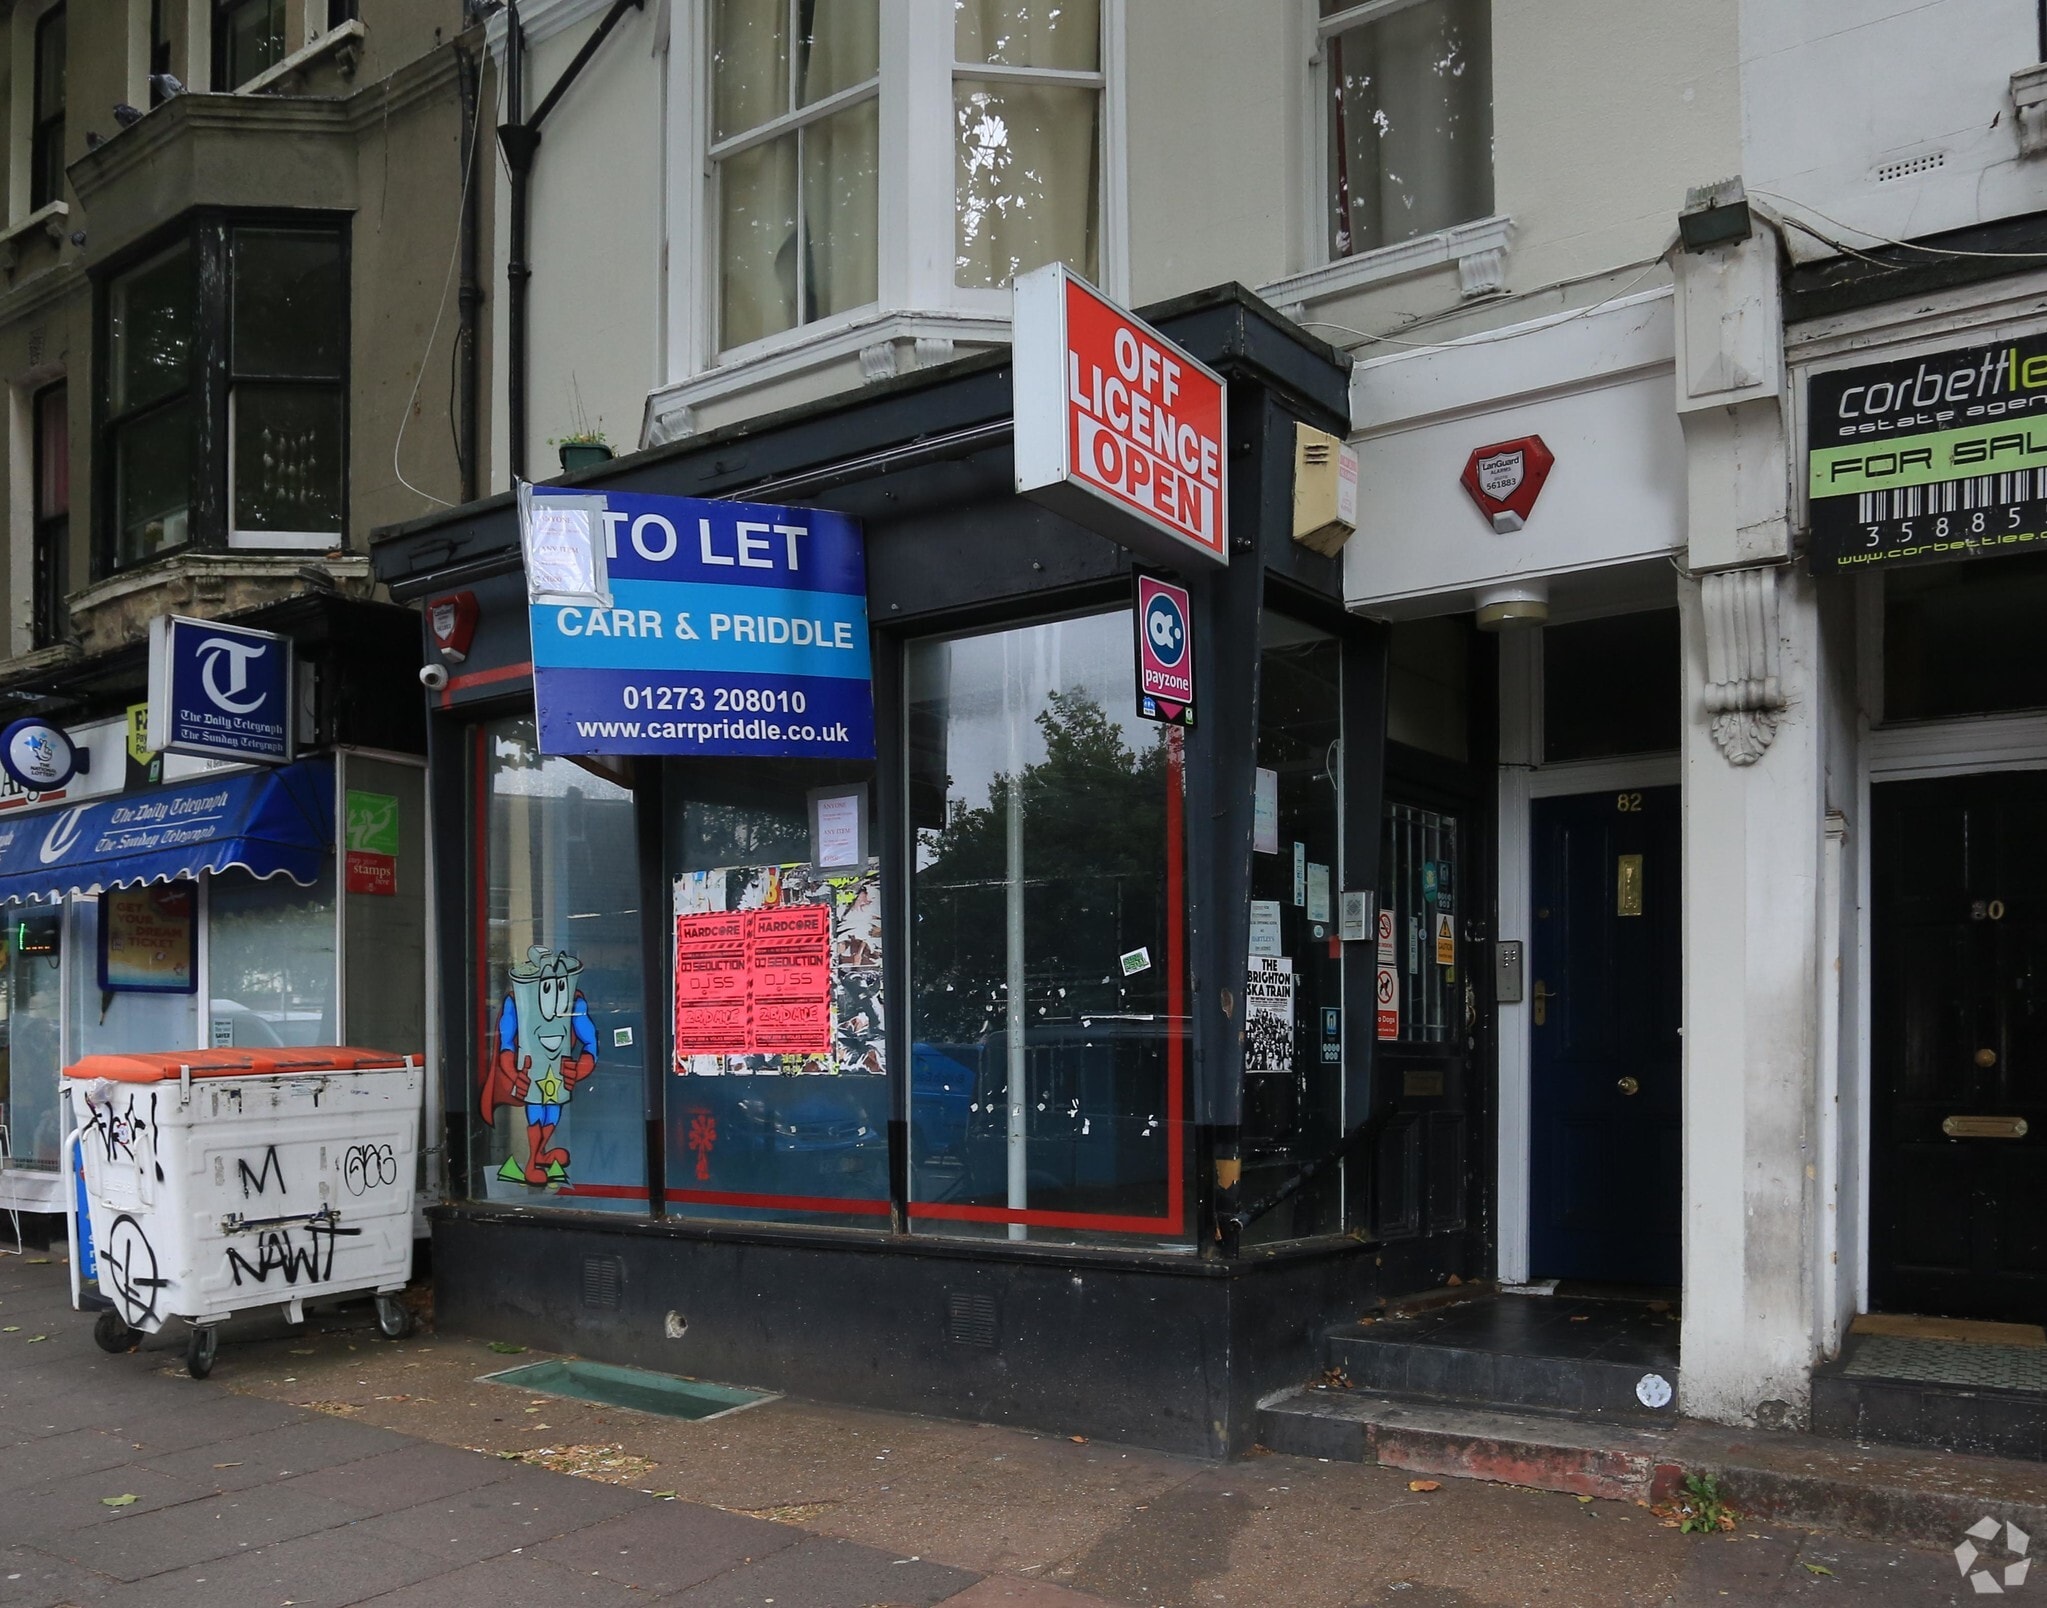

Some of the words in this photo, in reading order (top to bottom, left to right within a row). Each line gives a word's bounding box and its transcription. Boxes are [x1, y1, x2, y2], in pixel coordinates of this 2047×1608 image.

[1114, 327, 1181, 408] OFF
[1069, 349, 1219, 489] LICENCE
[1839, 409, 1955, 436] estate
[1482, 456, 1520, 471] LanGuard
[1831, 447, 1932, 483] FOR
[1952, 431, 2047, 466] SAL
[1092, 428, 1204, 534] OPEN
[1486, 478, 1517, 490] 561883
[601, 511, 678, 562] TO
[699, 518, 808, 571] LET
[557, 607, 663, 638] CARR
[675, 612, 700, 640] &
[710, 613, 855, 649] PRIDDLE
[1145, 668, 1189, 691] payzone
[623, 685, 706, 711] 01273
[713, 689, 807, 714] 208010
[180, 709, 202, 722] The
[204, 713, 232, 729] Daily
[233, 717, 283, 734] Telegraph
[576, 718, 849, 744] www.carrpriddle.co.uk
[181, 728, 199, 740] The
[202, 731, 239, 747] Sunday
[240, 737, 284, 751] Telegraph
[111, 807, 134, 825] The
[133, 803, 167, 821] Daily
[169, 791, 229, 815] Telegraph
[1617, 793, 1643, 812] 82
[95, 838, 115, 853] The
[116, 832, 159, 850] Sunday
[160, 825, 216, 844] Telegraph
[353, 864, 391, 879] stamps
[117, 902, 143, 912] GET
[117, 913, 154, 924] YOUR
[757, 919, 819, 933] HARDCORE
[136, 925, 183, 938] DREAM
[683, 925, 741, 938] HARDCORE
[127, 936, 176, 948] TICKET
[692, 960, 745, 972] SEDUCTION
[766, 955, 824, 968] SEDUCTION
[1261, 958, 1278, 971] THE
[712, 976, 735, 989] SS
[789, 972, 813, 985] SS
[1247, 970, 1291, 985] BRIGHTON
[1247, 983, 1265, 996] SKA
[1266, 984, 1291, 998] TRAIN
[1382, 1015, 1396, 1025] Dogs
